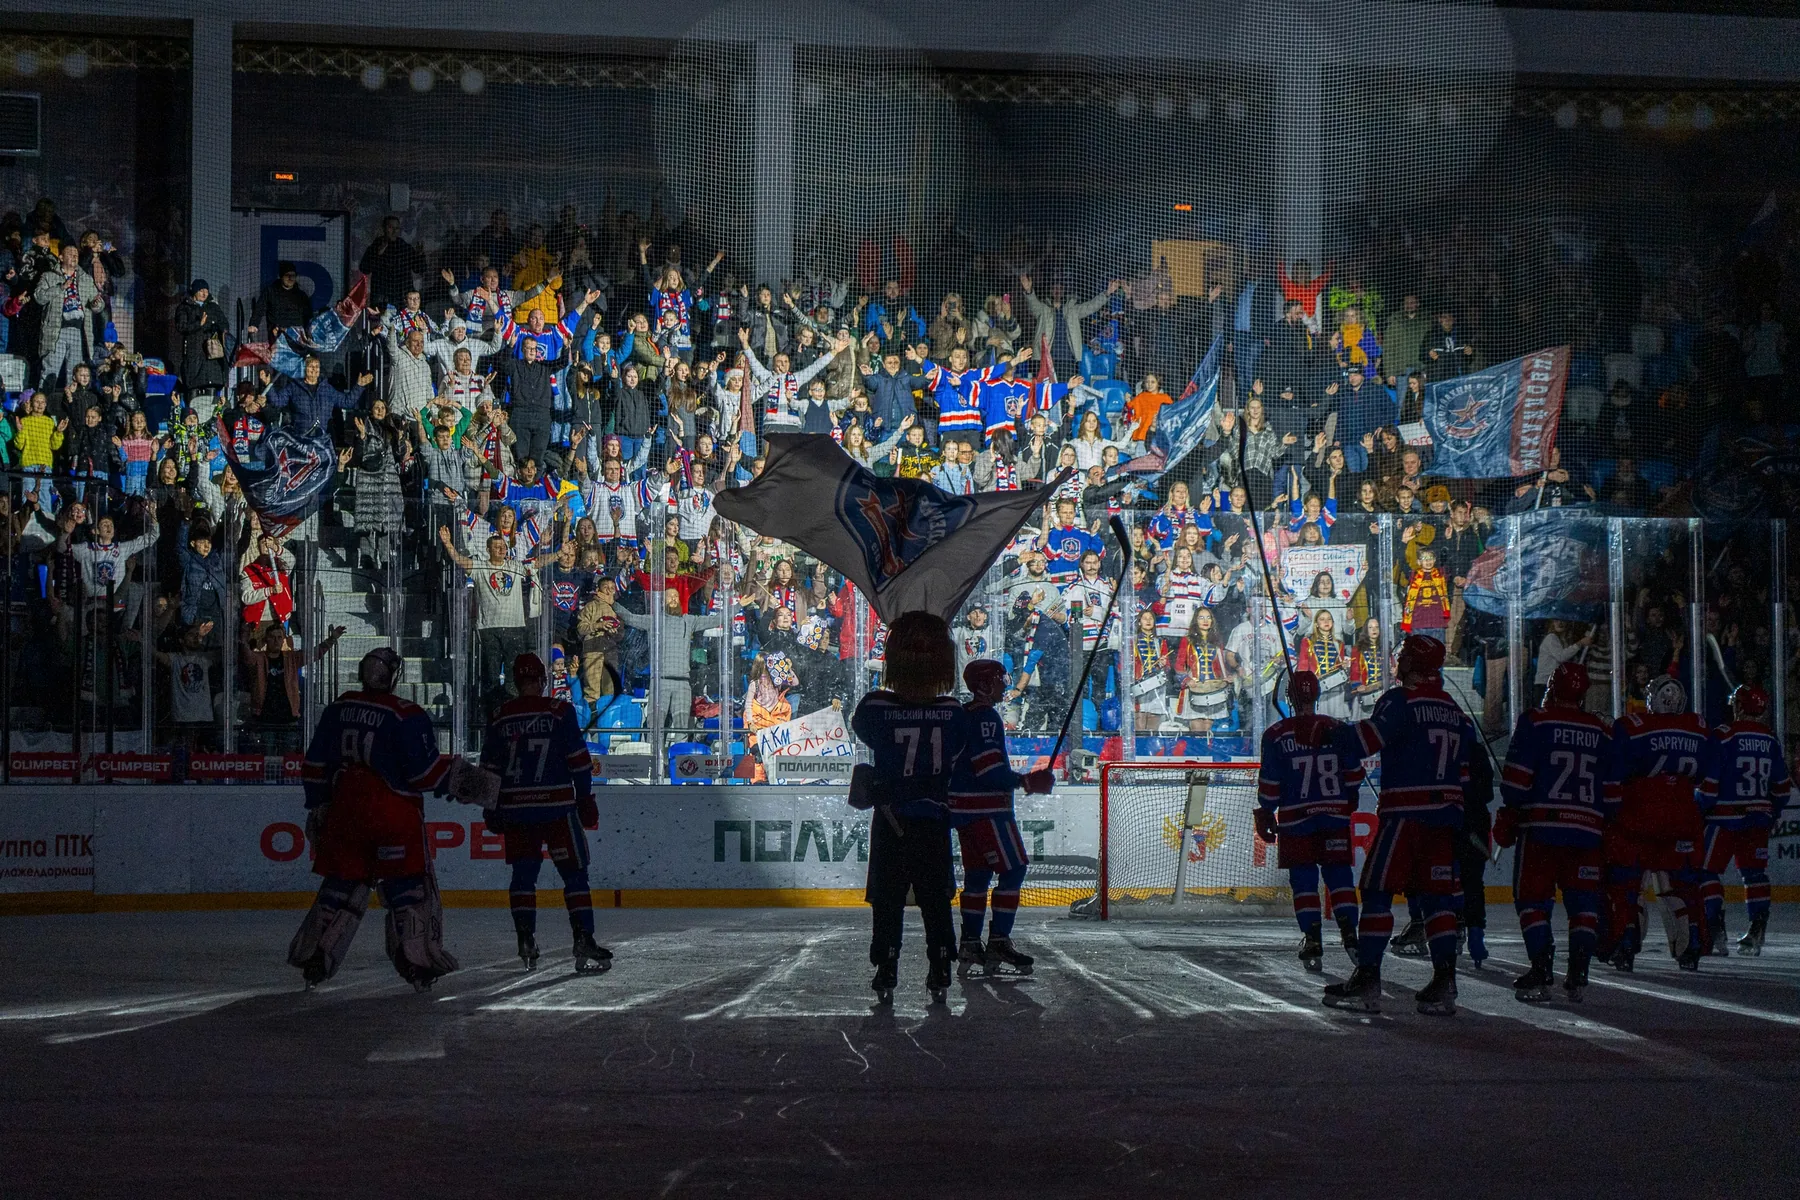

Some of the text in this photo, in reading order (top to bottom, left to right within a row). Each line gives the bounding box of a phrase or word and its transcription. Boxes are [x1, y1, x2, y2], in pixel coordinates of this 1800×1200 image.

[340, 706, 386, 728] KULIKOV
[884, 708, 953, 720] ТУЛЬСКИЙ МАСТЕР
[761, 726, 791, 755] АКМ
[980, 721, 997, 738] 67
[1554, 728, 1600, 748] PETROV
[768, 726, 843, 757] ТОЛЬКО
[894, 726, 944, 777] 71
[1738, 738, 1771, 753] SHIPOV
[12, 760, 79, 771] OLIMPBET
[100, 760, 170, 772] OLIMPBET
[191, 760, 264, 772] OLIMPBET
[505, 738, 550, 784] 47
[778, 762, 852, 773] ПОЛИПЛАСТ
[1292, 754, 1341, 799] 78
[1548, 750, 1598, 803] 25
[1736, 756, 1772, 797] 38
[55, 834, 94, 857] ПТК
